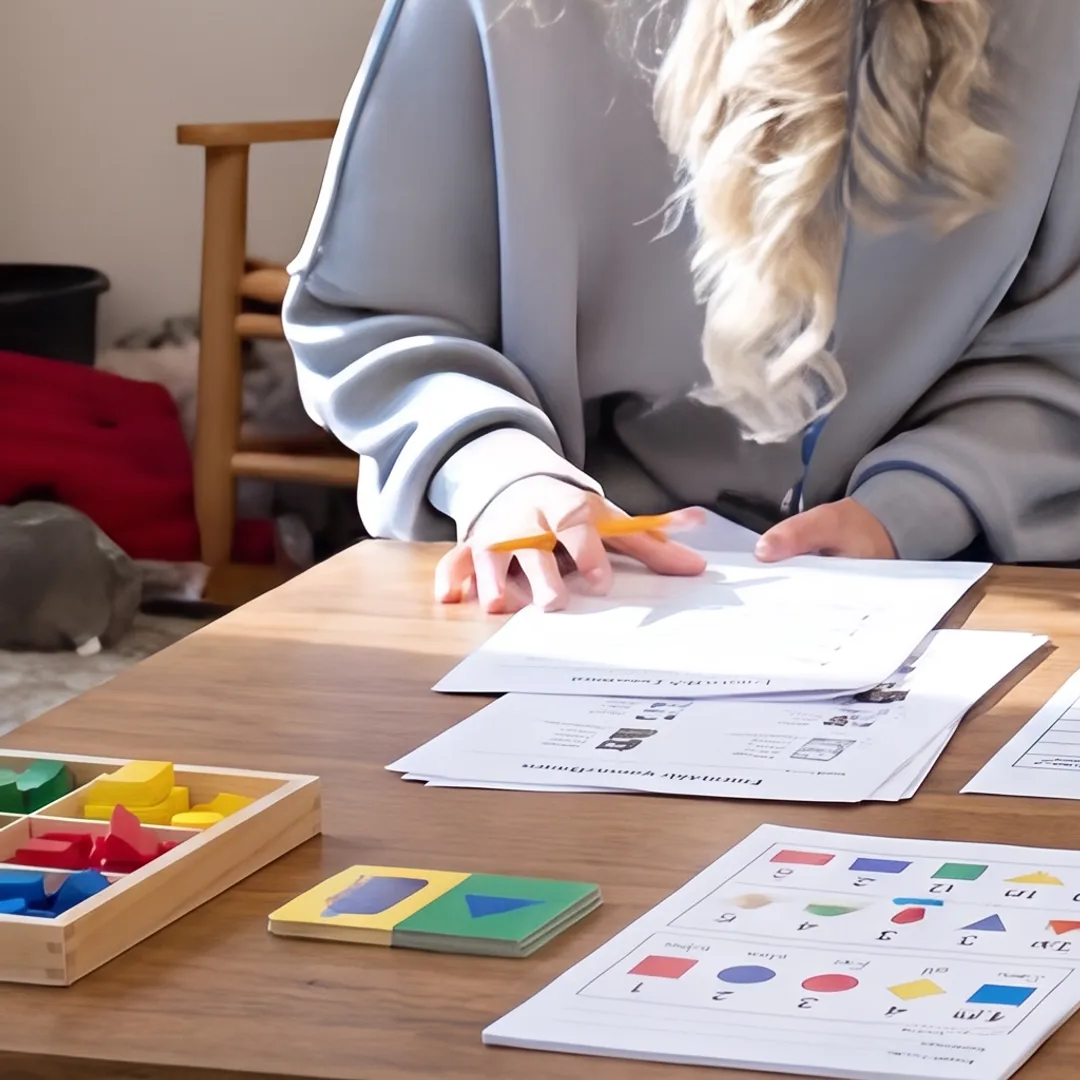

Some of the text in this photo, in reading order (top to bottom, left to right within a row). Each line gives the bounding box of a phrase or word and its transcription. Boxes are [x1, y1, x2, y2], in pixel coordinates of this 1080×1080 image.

[929, 883, 954, 894] 12
[630, 982, 644, 994] 1
[712, 990, 734, 1001] 2
[798, 997, 819, 1009] 3
